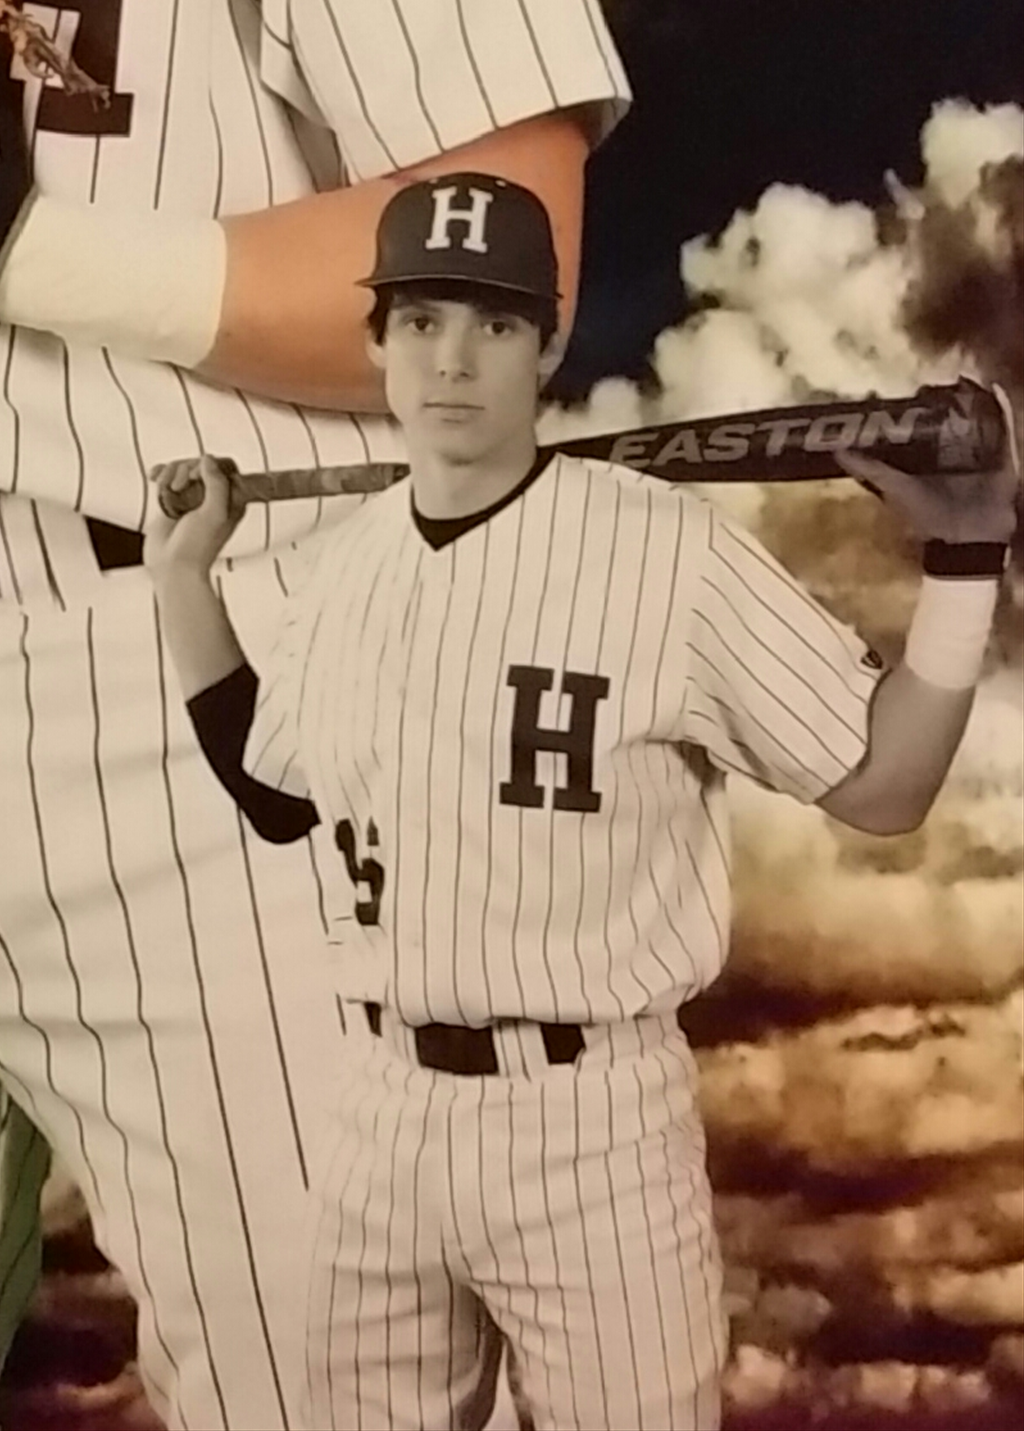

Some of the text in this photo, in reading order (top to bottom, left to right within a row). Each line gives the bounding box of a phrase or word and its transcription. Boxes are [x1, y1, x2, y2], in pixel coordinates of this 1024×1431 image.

[425, 185, 494, 255] H
[606, 406, 933, 469] EASTON
[499, 665, 610, 814] H
